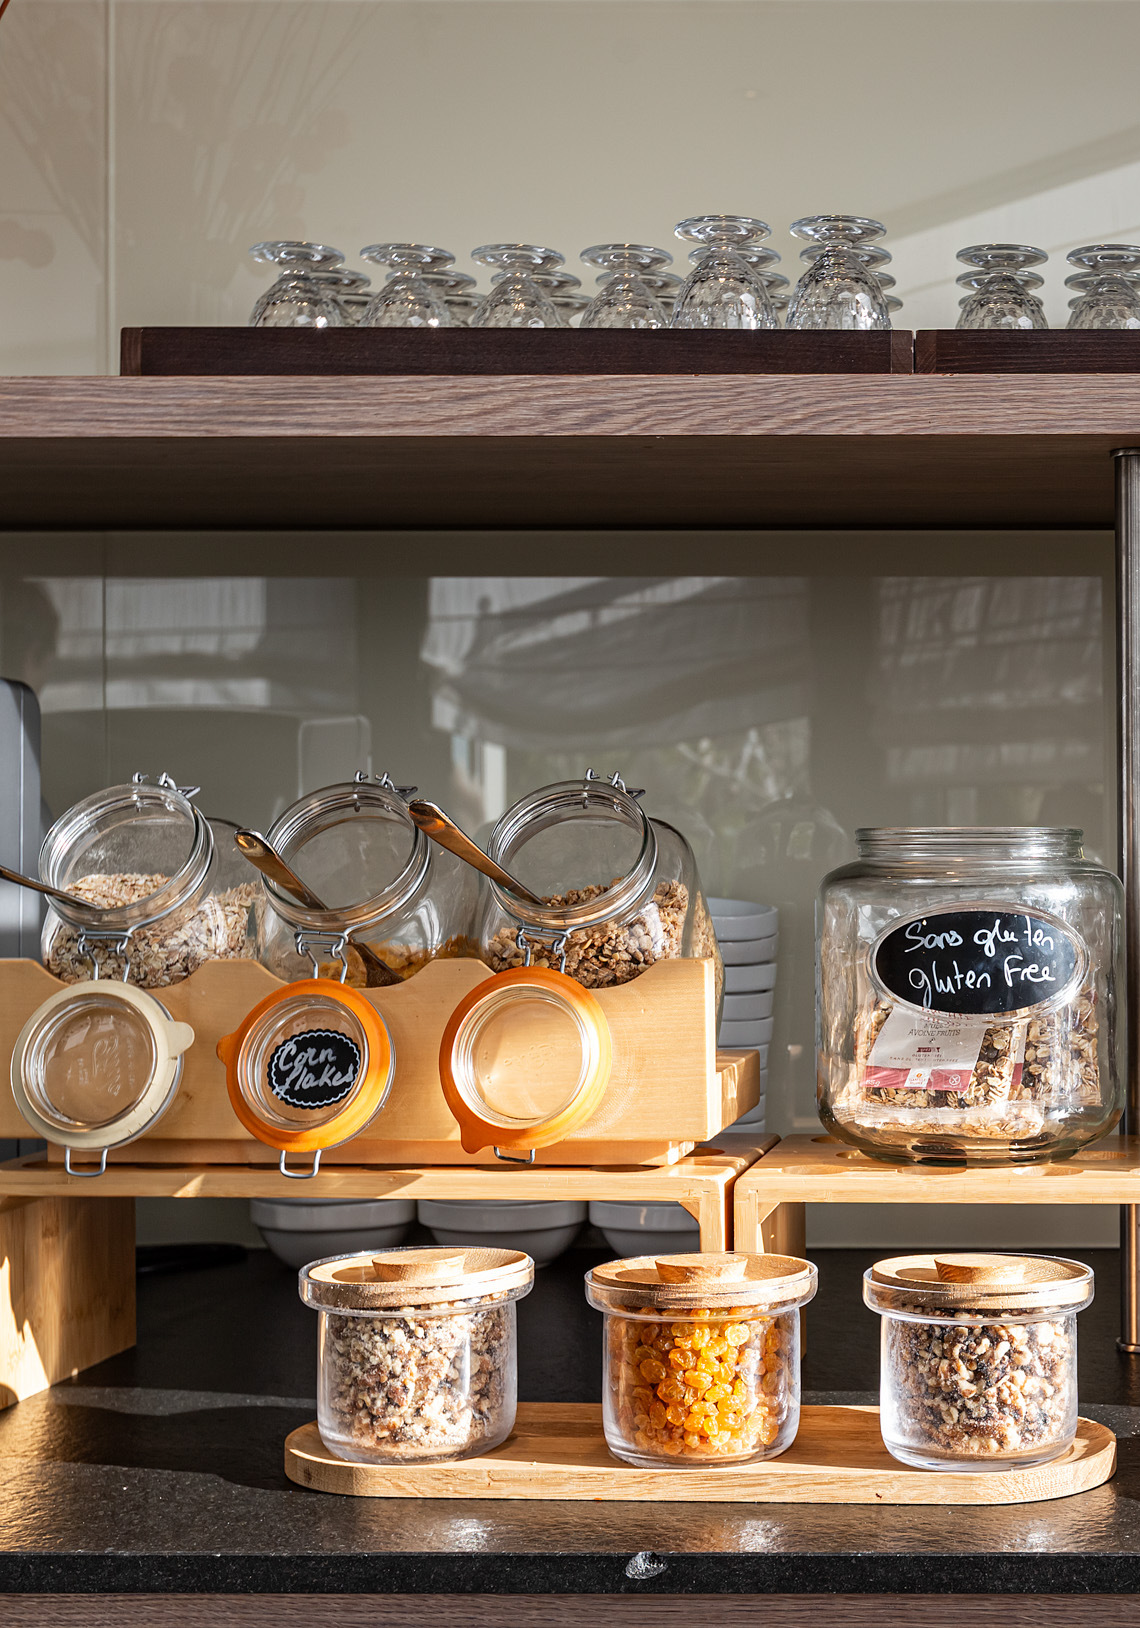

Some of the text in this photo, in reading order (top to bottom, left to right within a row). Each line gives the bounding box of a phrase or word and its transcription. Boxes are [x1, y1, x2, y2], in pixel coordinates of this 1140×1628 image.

[904, 915, 1054, 957] Sans gluten
[1004, 954, 1056, 987] Free
[279, 1042, 337, 1071] Corn
